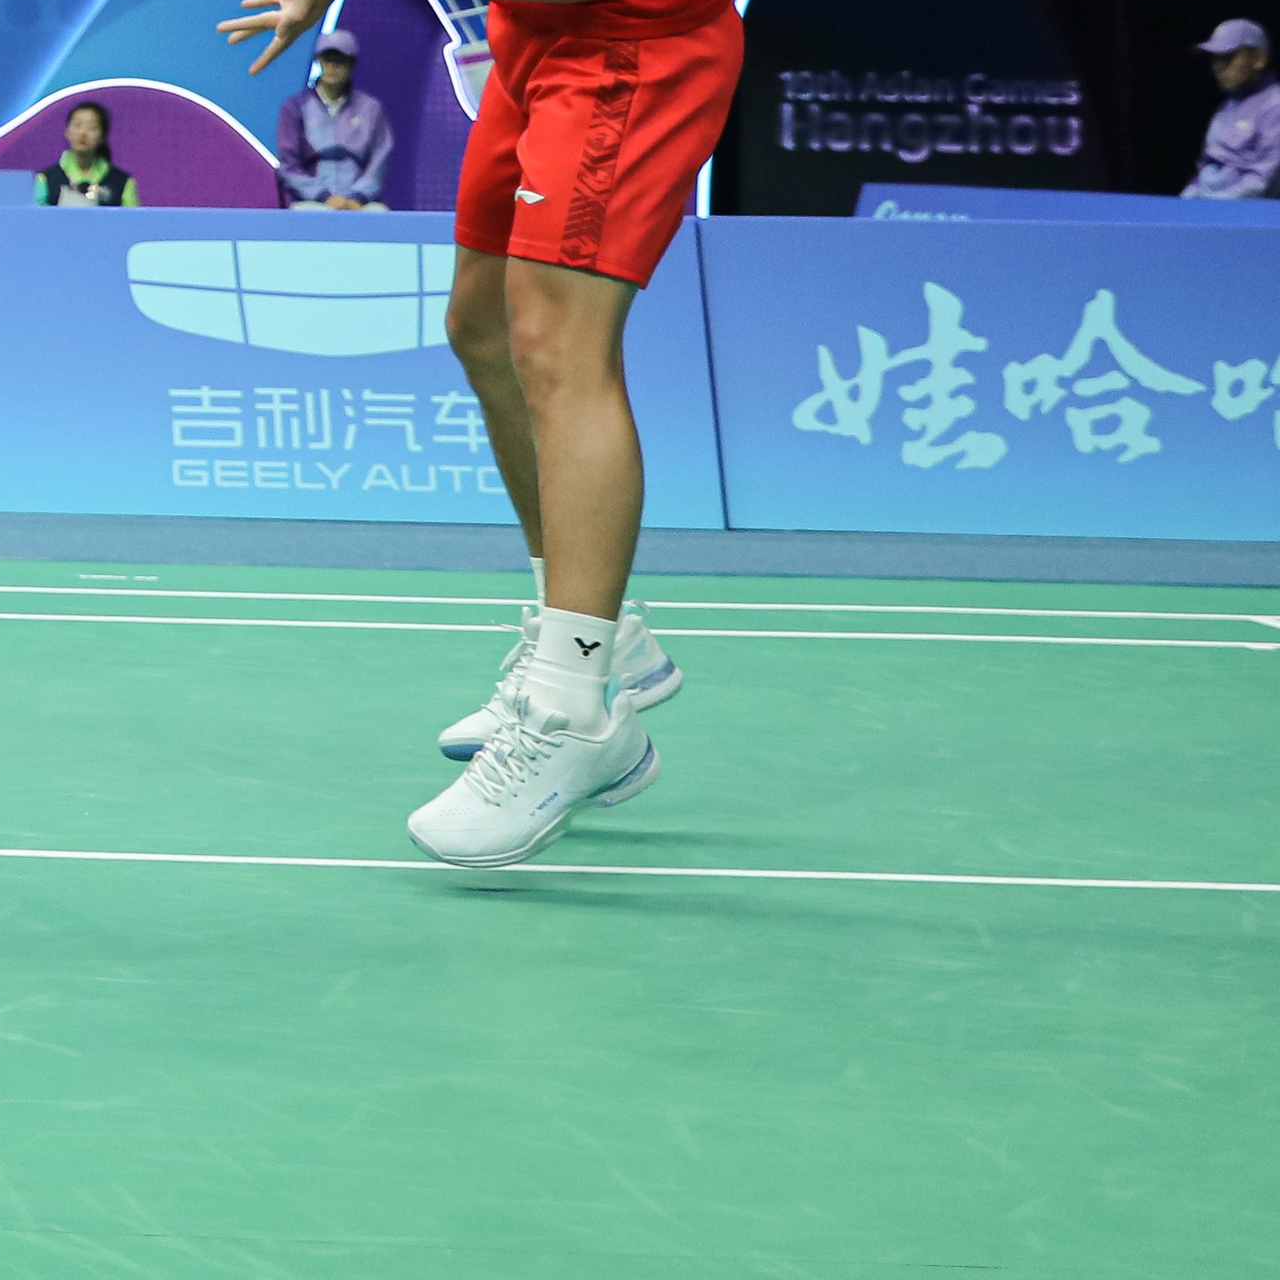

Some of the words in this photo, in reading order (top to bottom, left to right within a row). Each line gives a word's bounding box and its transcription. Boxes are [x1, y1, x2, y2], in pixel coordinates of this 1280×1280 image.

[779, 102, 1083, 163] Hangzhou
[168, 385, 490, 454] 吉利汽车
[172, 459, 352, 489] GEELY
